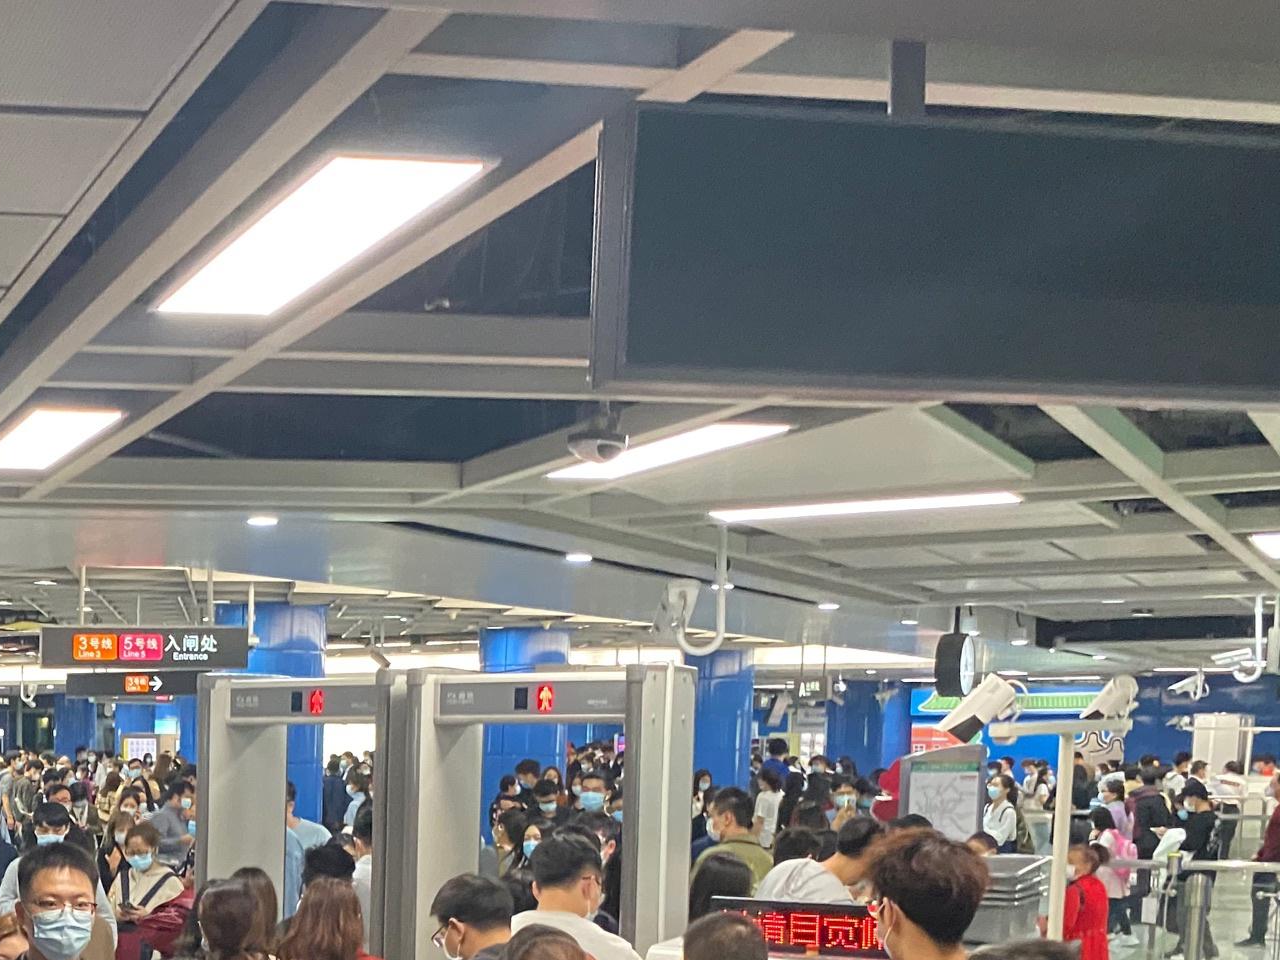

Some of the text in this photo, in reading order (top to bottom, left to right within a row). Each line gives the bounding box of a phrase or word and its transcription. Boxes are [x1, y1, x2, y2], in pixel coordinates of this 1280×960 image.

[79, 637, 112, 650] 3号线
[124, 636, 158, 650] 5号线
[164, 634, 217, 652] 入闸处
[173, 652, 209, 661] Entrance
